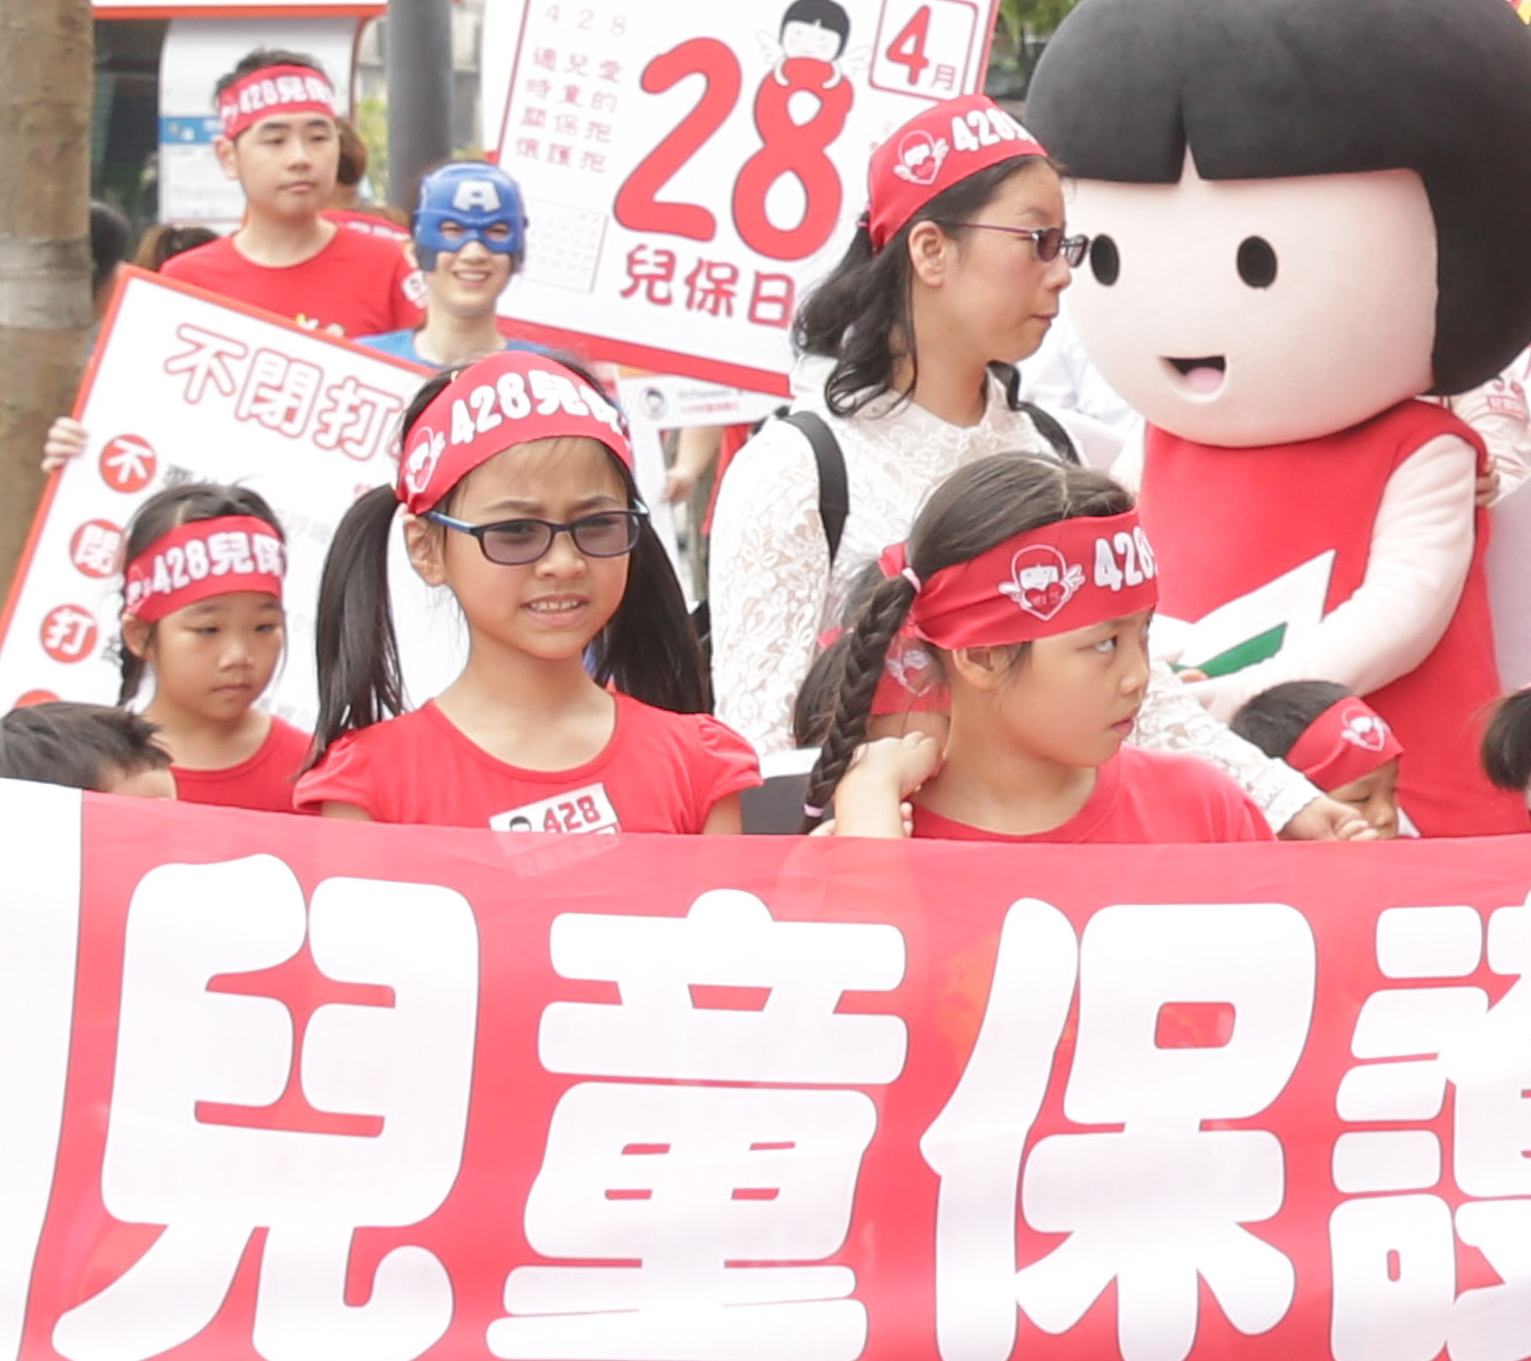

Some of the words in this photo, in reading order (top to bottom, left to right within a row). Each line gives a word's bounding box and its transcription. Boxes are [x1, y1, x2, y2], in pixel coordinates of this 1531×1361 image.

[614, 37, 855, 263] 28
[619, 244, 797, 330] 兒保日
[163, 322, 405, 463] 不閉打
[106, 440, 154, 485] 不
[47, 608, 94, 653] 打
[542, 794, 601, 834] 428
